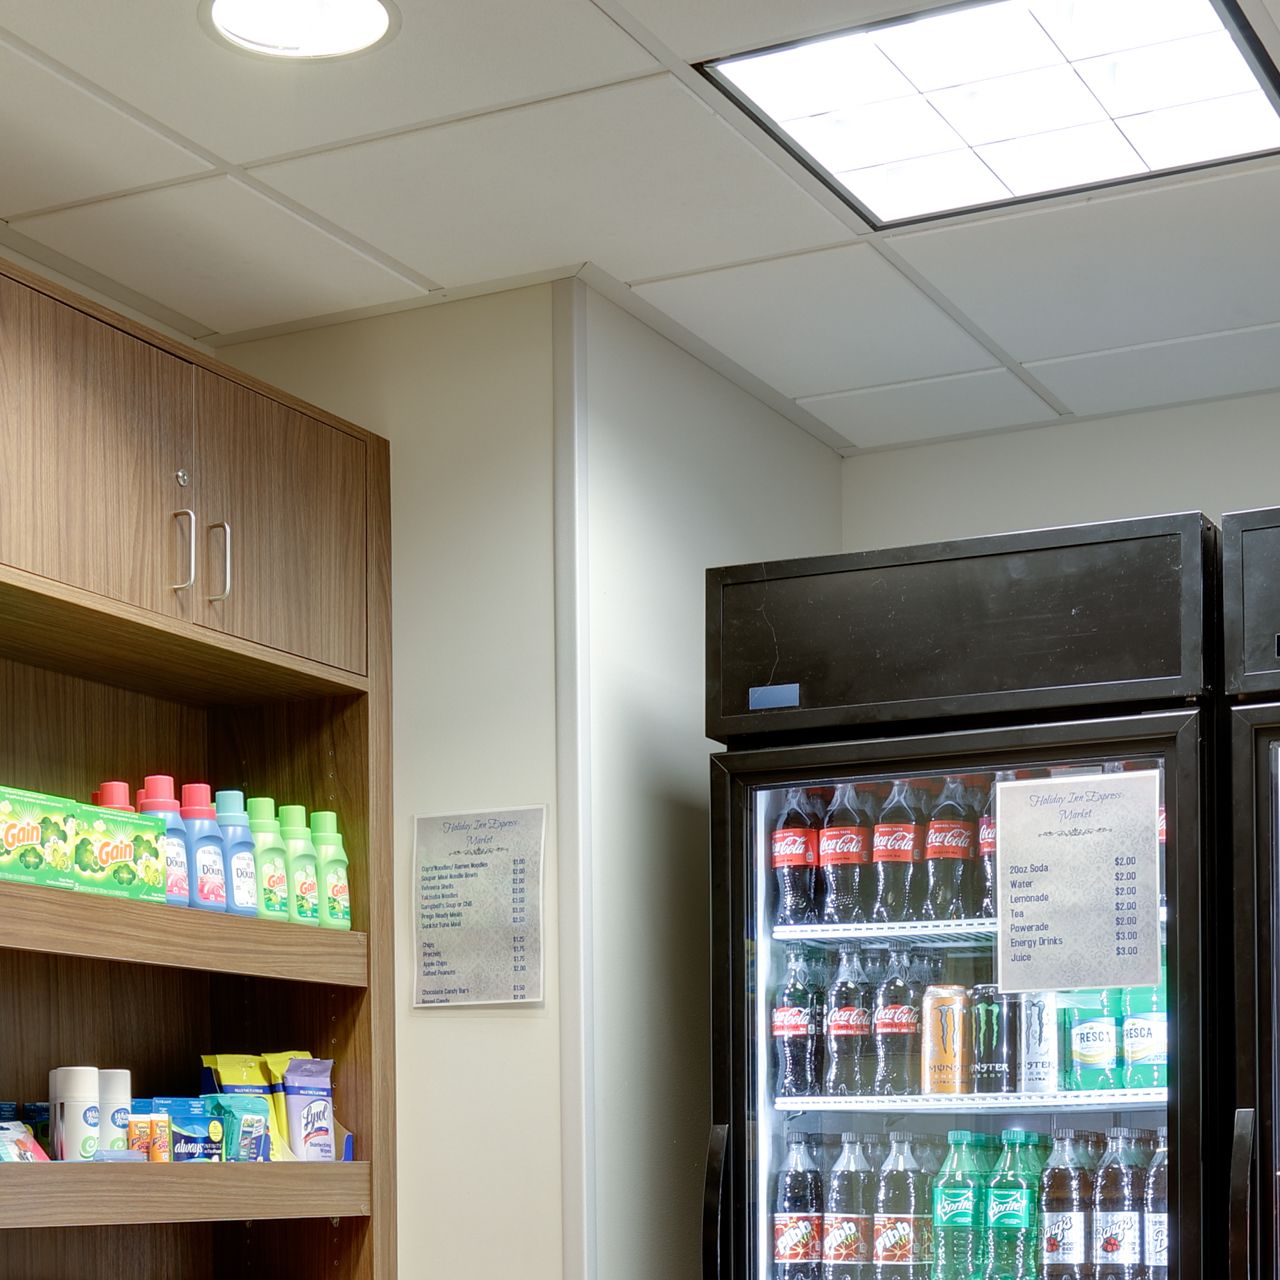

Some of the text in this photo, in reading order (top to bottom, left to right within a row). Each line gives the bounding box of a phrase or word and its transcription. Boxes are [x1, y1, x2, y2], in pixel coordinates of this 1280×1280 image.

[1030, 791, 1121, 807] Holiday Inn Express
[1059, 809, 1092, 823] Market
[4, 822, 41, 849] Gain
[98, 841, 133, 865] Gain
[1114, 857, 1136, 866] $2.00
[1010, 864, 1048, 875] 20oz Soda
[1114, 872, 1136, 881] $2.00
[1010, 880, 1033, 889] Water
[1115, 887, 1137, 896] $2.00
[1010, 893, 1049, 904] Lemonade
[1115, 902, 1137, 911] $2.00
[1011, 910, 1024, 918] Tea
[1115, 916, 1137, 926] $2.00
[1010, 923, 1049, 933] Powerade
[1115, 931, 1138, 941] $3.00
[1010, 937, 1063, 948] Energy Drinks
[1116, 946, 1138, 956] $3.00
[1011, 953, 1031, 962] Juice
[303, 1103, 327, 1132] Lysol
[175, 1139, 203, 1157] always
[941, 1199, 974, 1214] Sprite
[991, 1199, 1025, 1214] Sprite
[777, 1220, 812, 1255] Pibb
[823, 1221, 857, 1255] Pibb
[875, 1221, 910, 1255] Pibb
